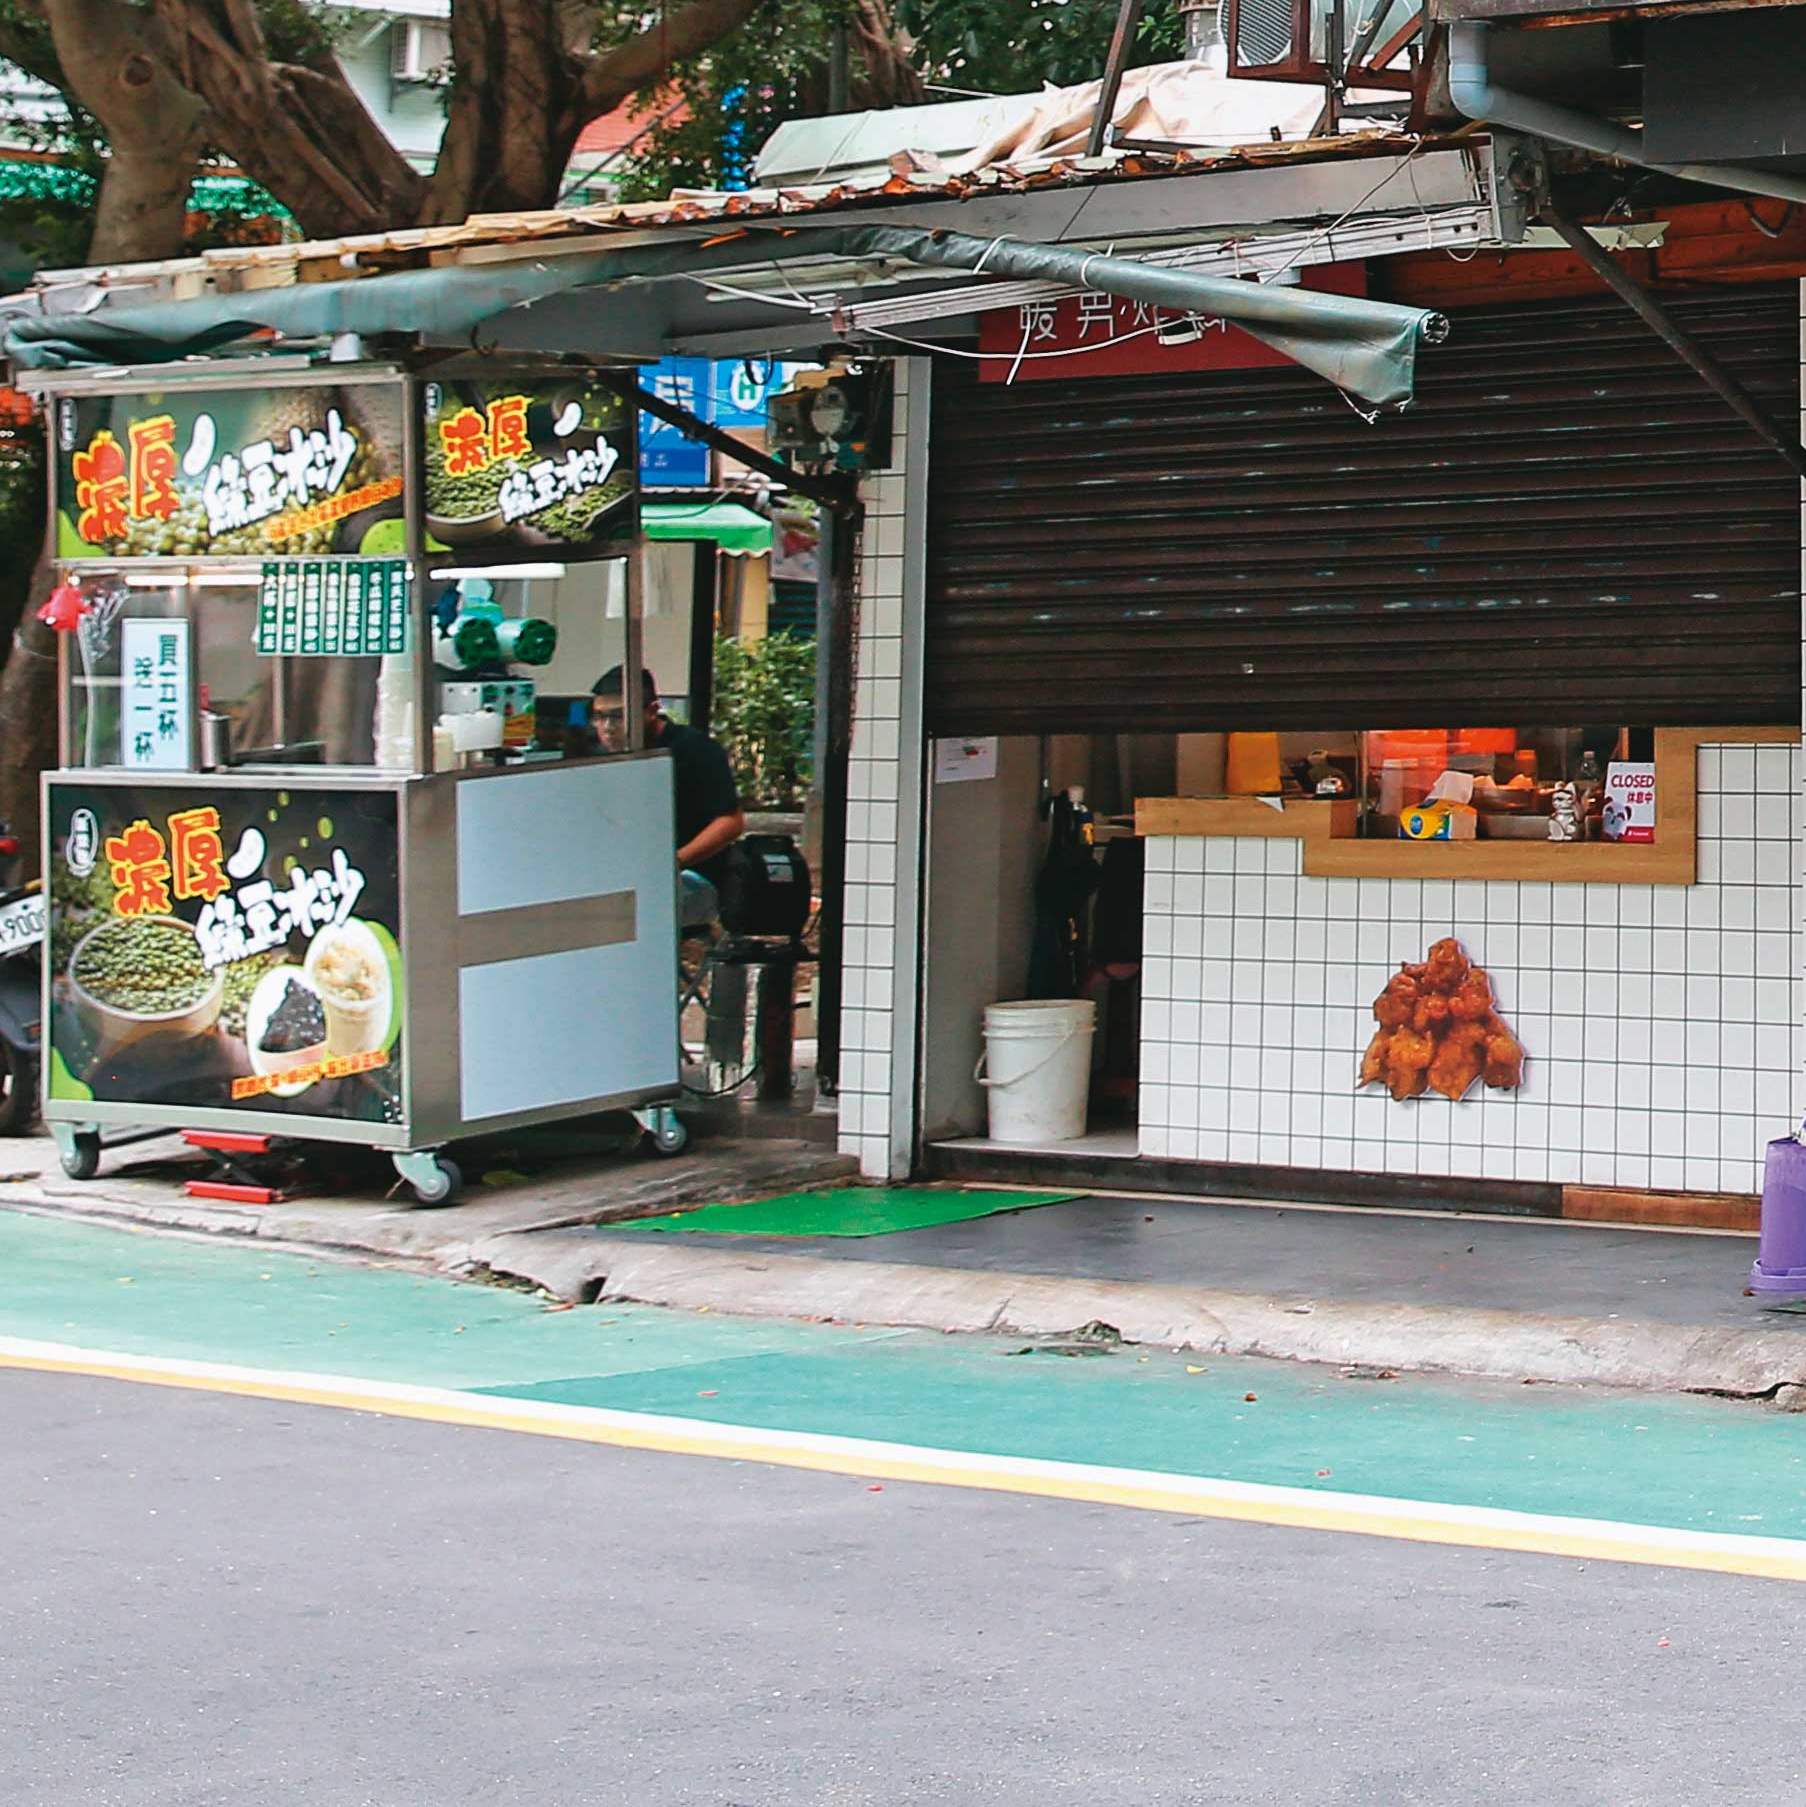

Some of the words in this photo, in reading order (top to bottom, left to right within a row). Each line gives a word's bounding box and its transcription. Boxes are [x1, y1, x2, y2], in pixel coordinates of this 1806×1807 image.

[158, 634, 179, 741] 買五杯
[1611, 774, 1655, 788] CLOSED
